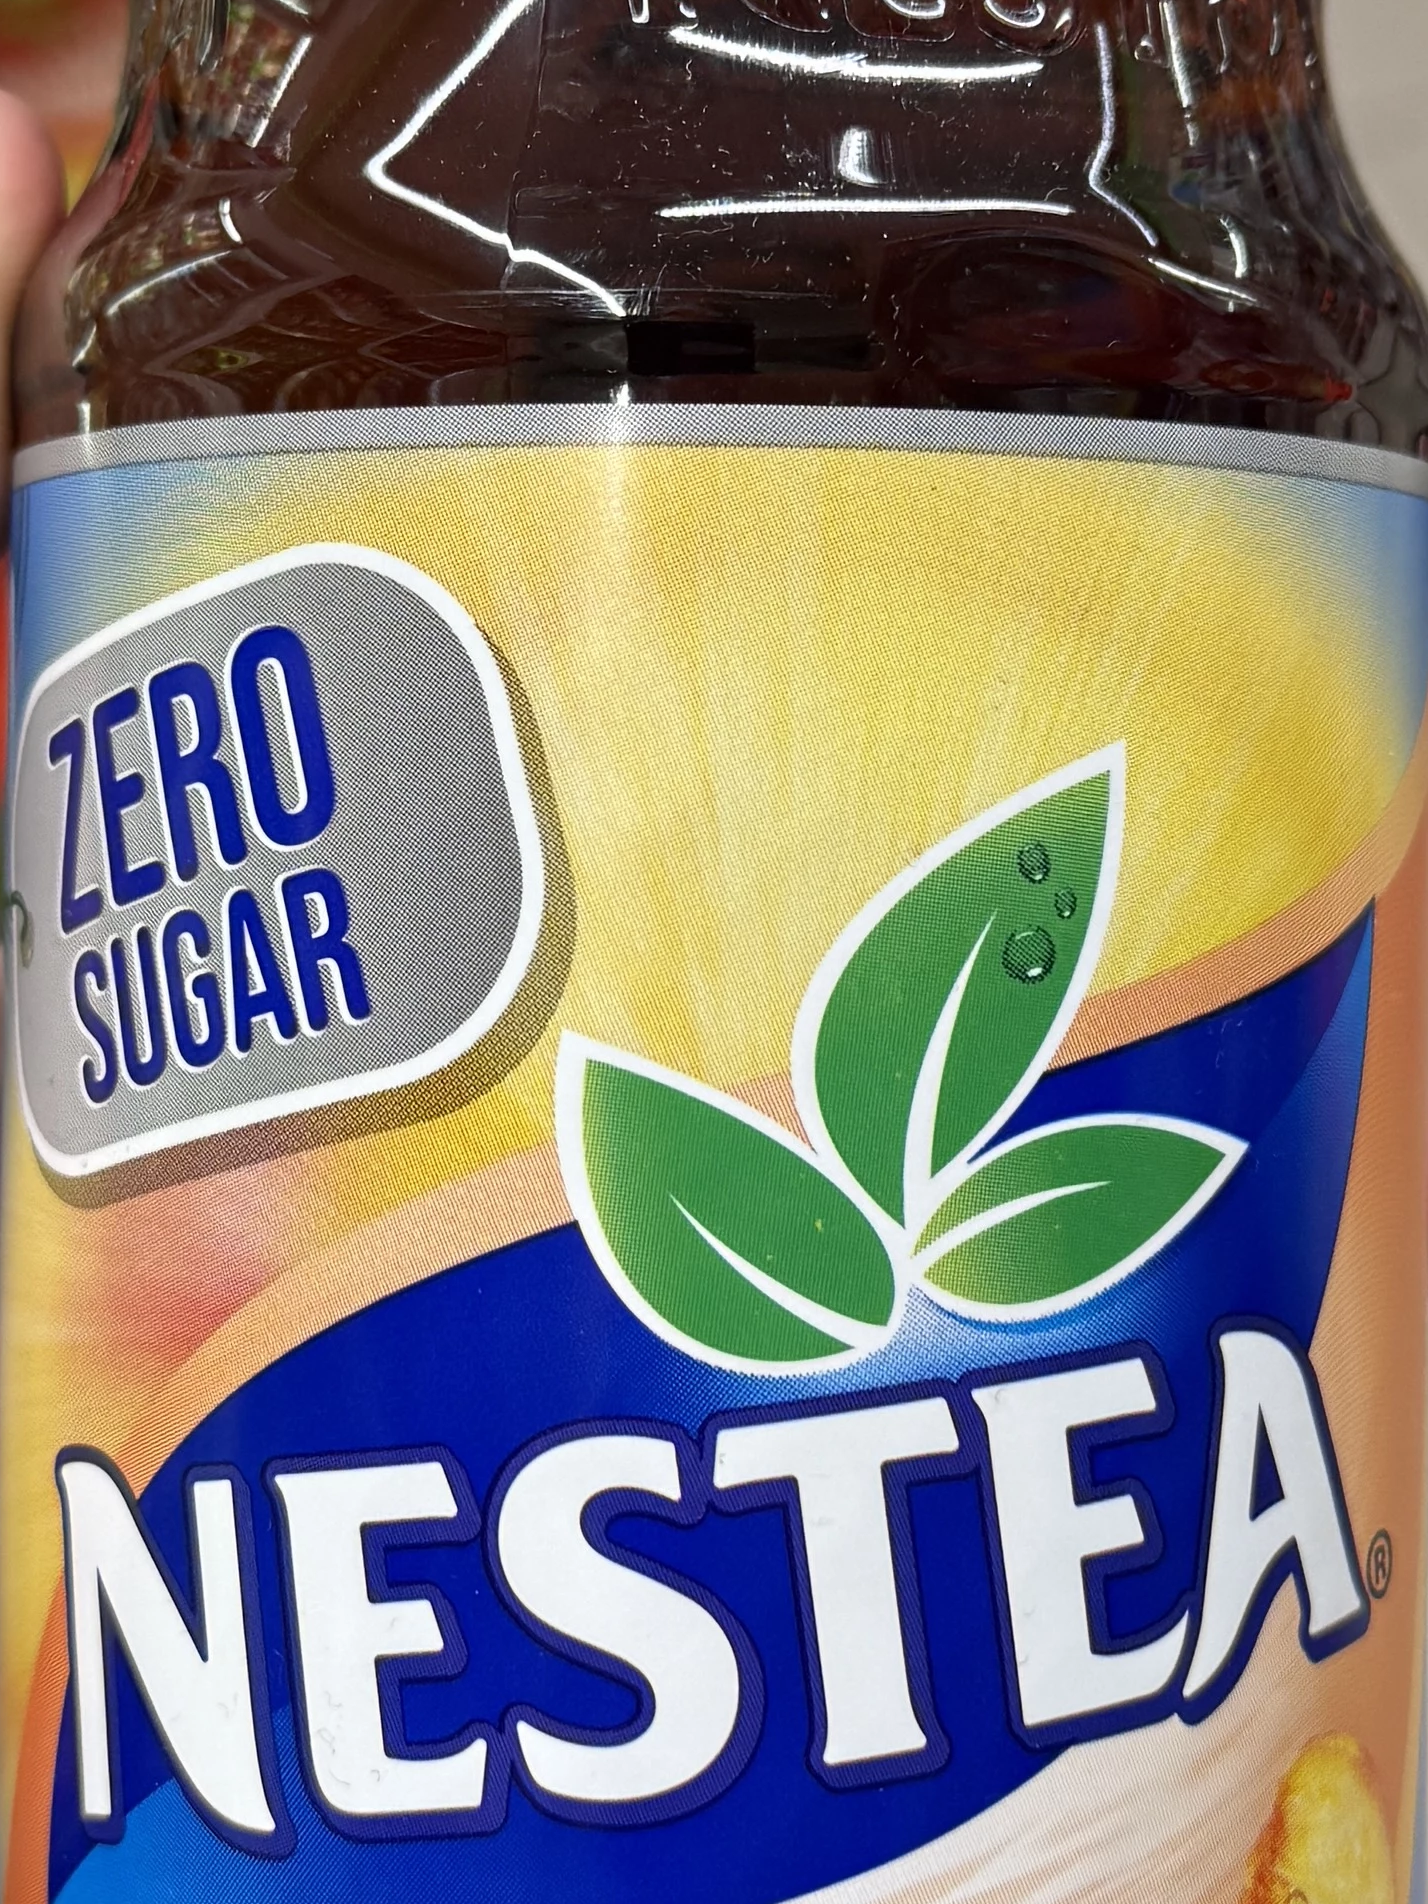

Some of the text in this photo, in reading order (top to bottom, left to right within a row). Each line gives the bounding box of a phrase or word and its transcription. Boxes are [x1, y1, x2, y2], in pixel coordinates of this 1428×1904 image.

[46, 623, 338, 937] ZERO
[71, 866, 373, 1106] SUGAR
[57, 1321, 1367, 1851] NESTEA
